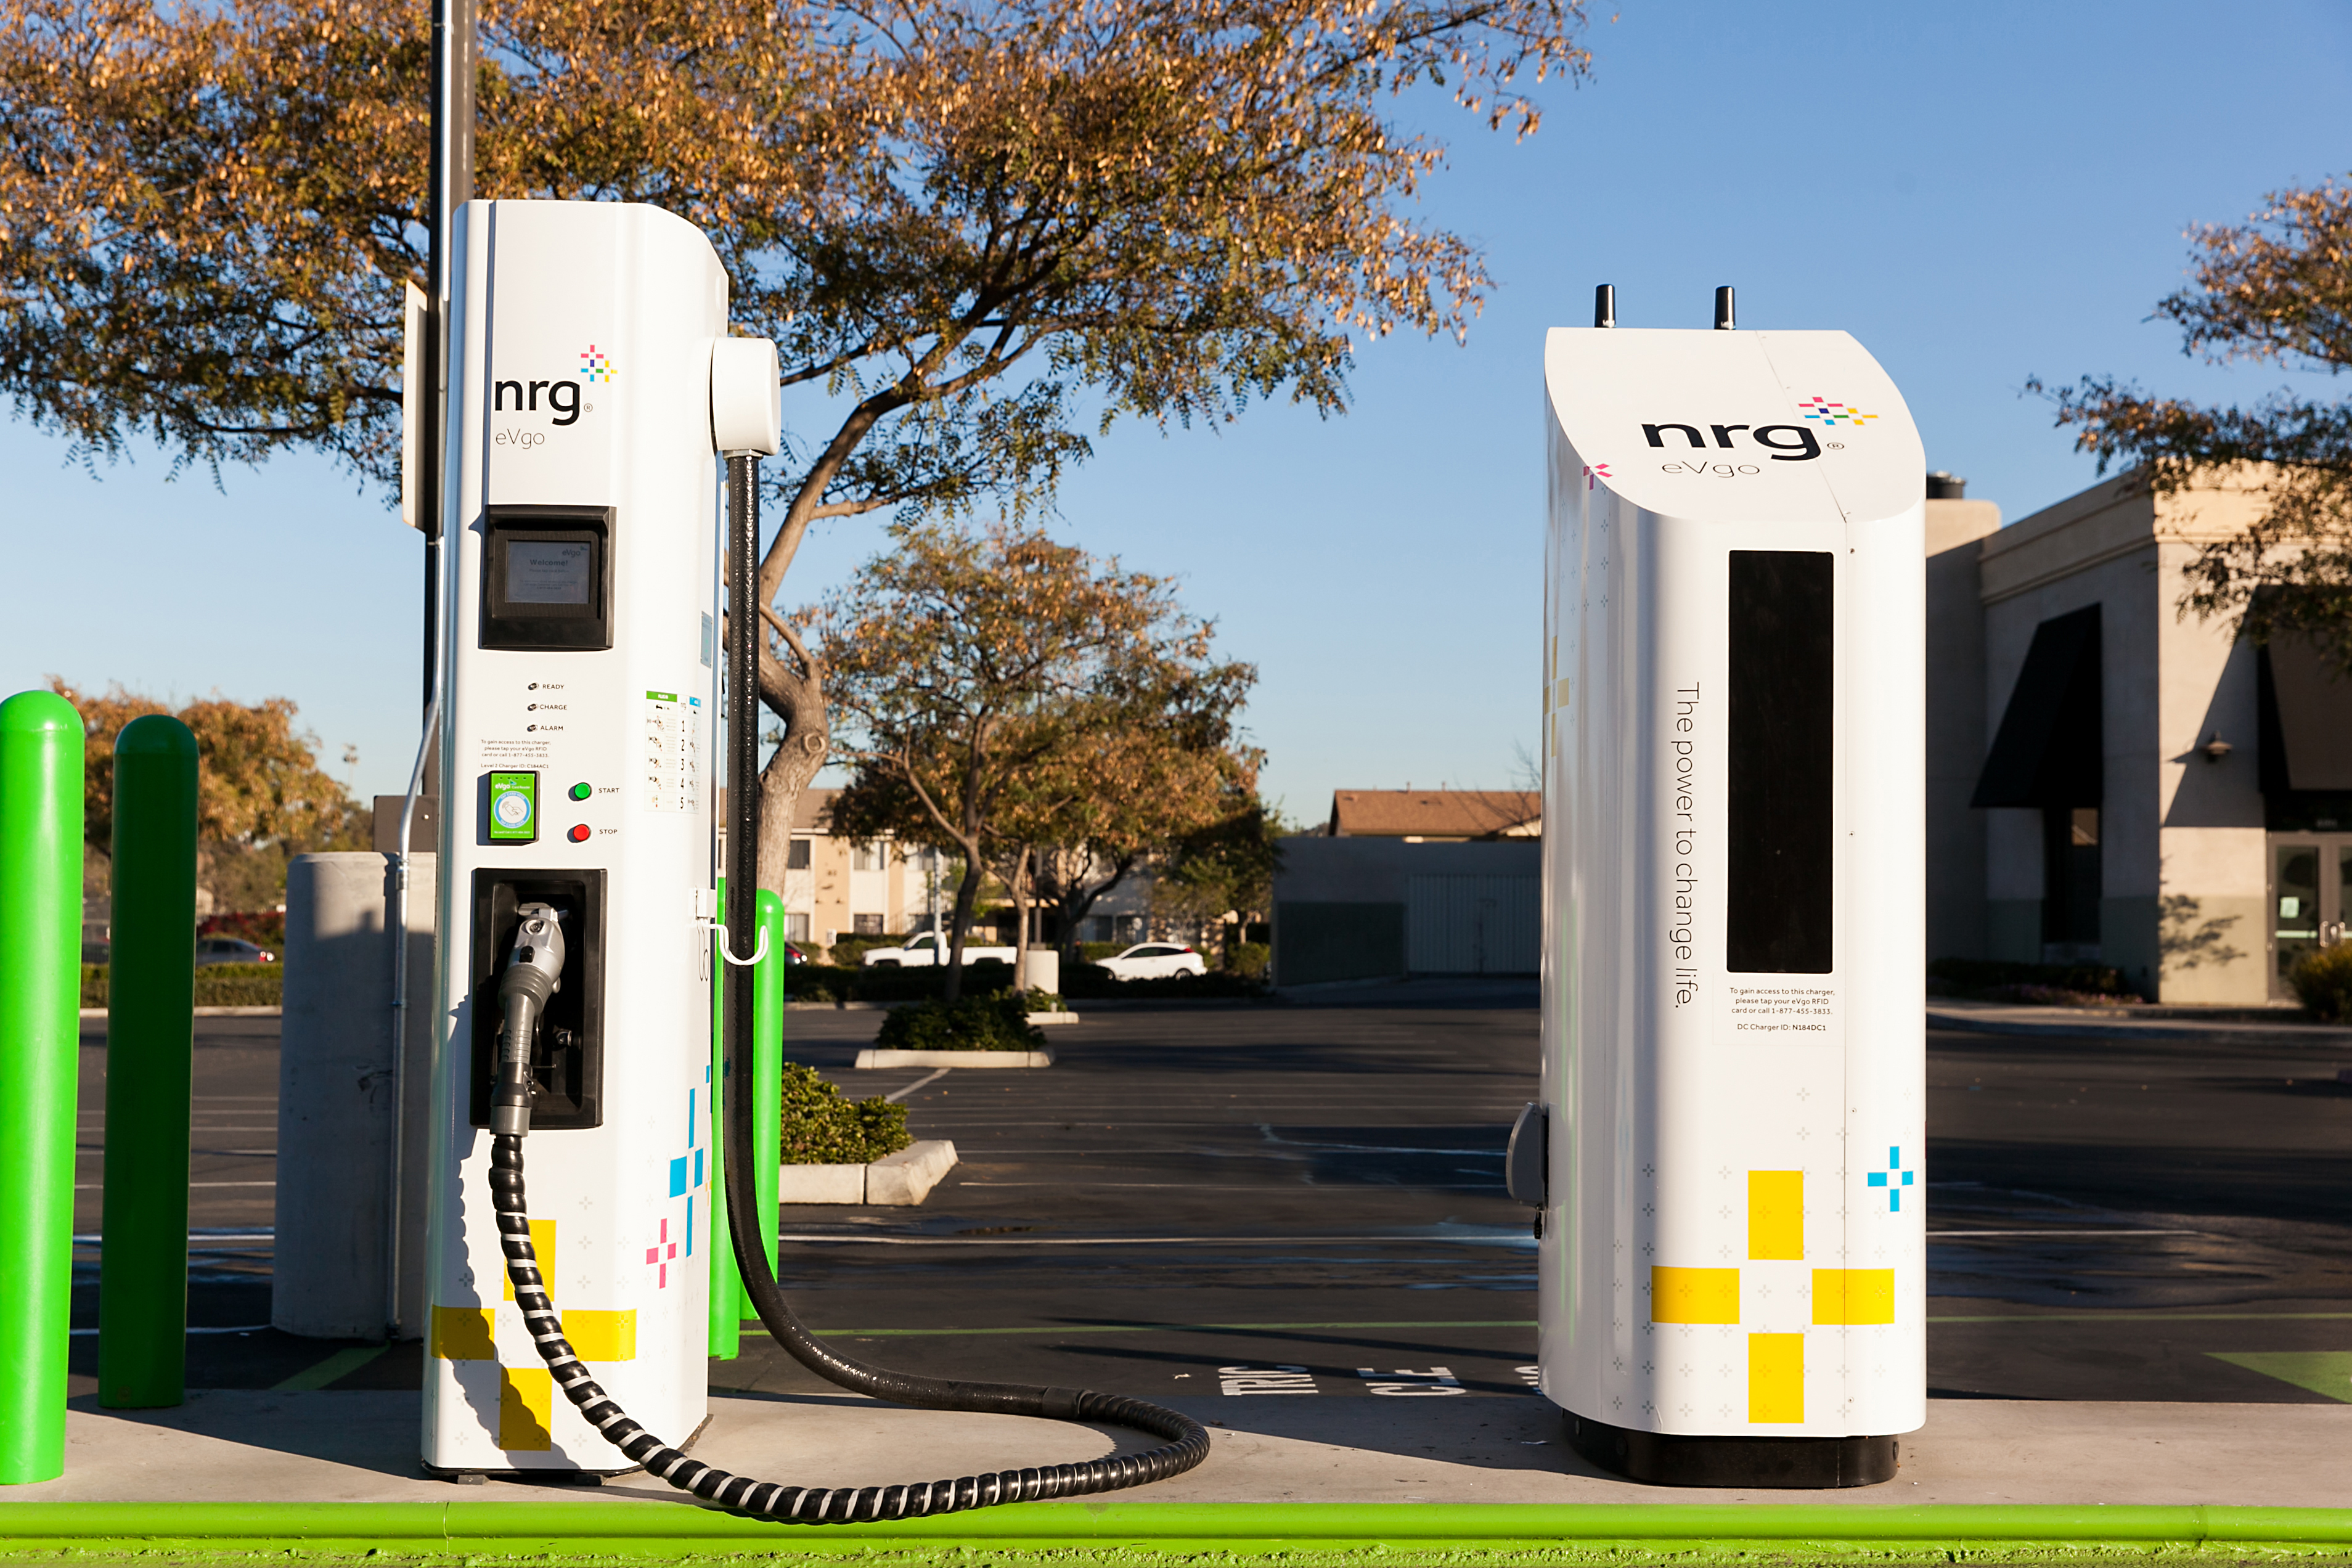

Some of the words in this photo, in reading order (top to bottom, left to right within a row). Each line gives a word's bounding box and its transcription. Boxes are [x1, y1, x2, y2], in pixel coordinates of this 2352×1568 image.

[495, 380, 580, 426] nrg
[496, 428, 545, 449] eVgo
[1641, 423, 1821, 461] nrg
[1662, 461, 1760, 478] eVgo
[562, 549, 581, 558] eVgo
[1676, 682, 1699, 732] The
[682, 720, 685, 732] 1
[681, 739, 685, 751] 2
[680, 758, 685, 770] 3
[680, 778, 684, 790] 4
[1671, 741, 1693, 822] power
[680, 797, 684, 809] 5
[1676, 828, 1696, 855] to
[1669, 864, 1698, 960] change
[1675, 968, 1698, 1008] life.
[1792, 998, 1810, 1006] eVgo
[1750, 1024, 1779, 1032] Charger
